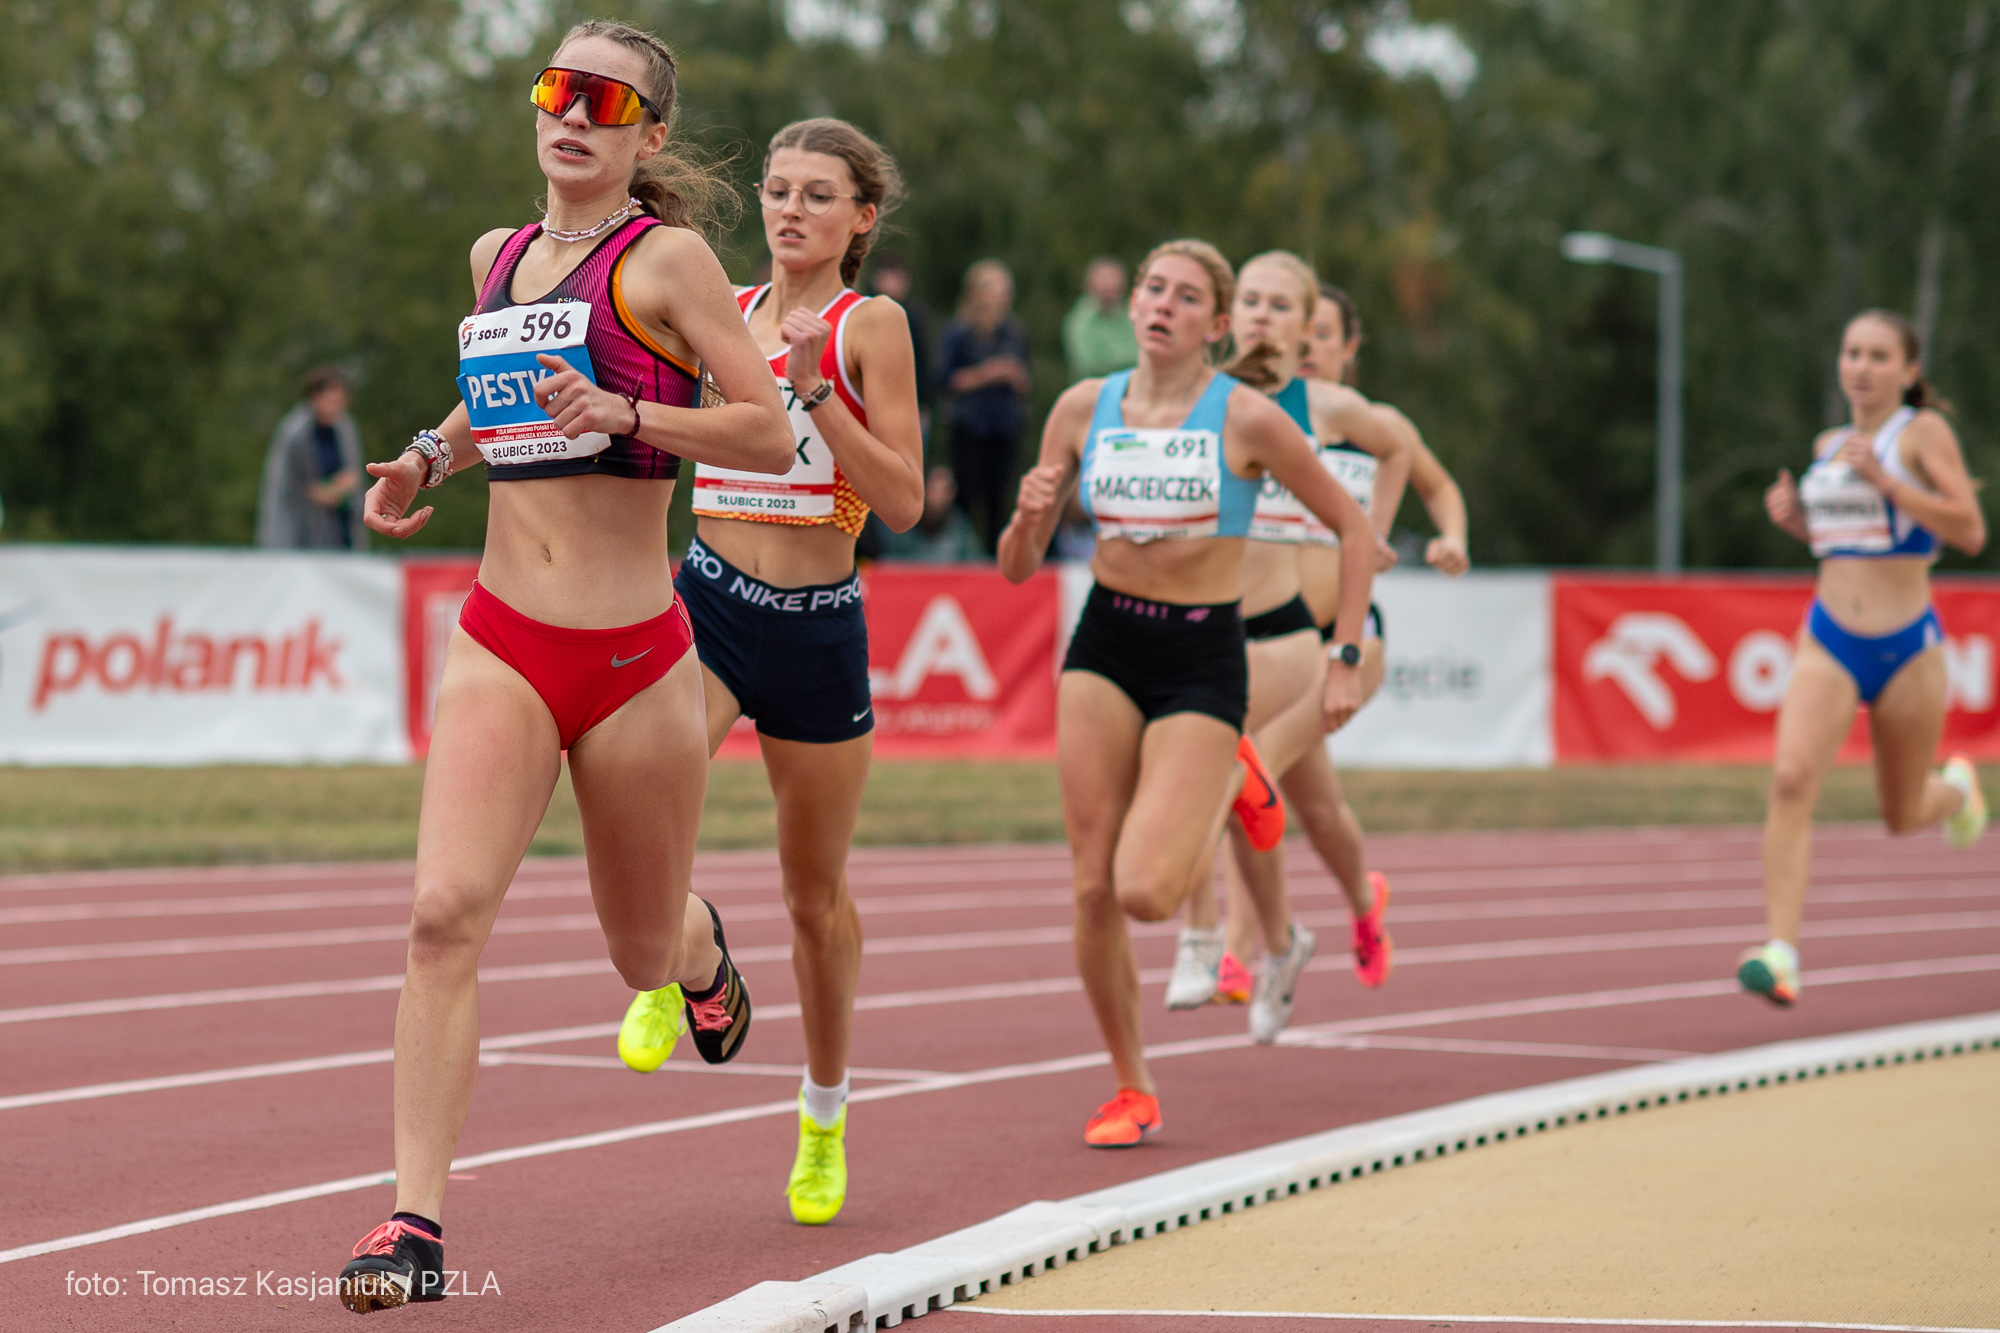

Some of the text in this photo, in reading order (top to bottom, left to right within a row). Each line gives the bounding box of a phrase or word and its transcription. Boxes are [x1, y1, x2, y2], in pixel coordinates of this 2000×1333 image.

[520, 310, 571, 342] 596
[492, 441, 567, 459] SŁUBICE 2023
[1165, 437, 1209, 458] 691
[717, 495, 796, 509] SŁUBICE 2023
[729, 576, 807, 611] NIKE
[28, 607, 350, 716] polanik
